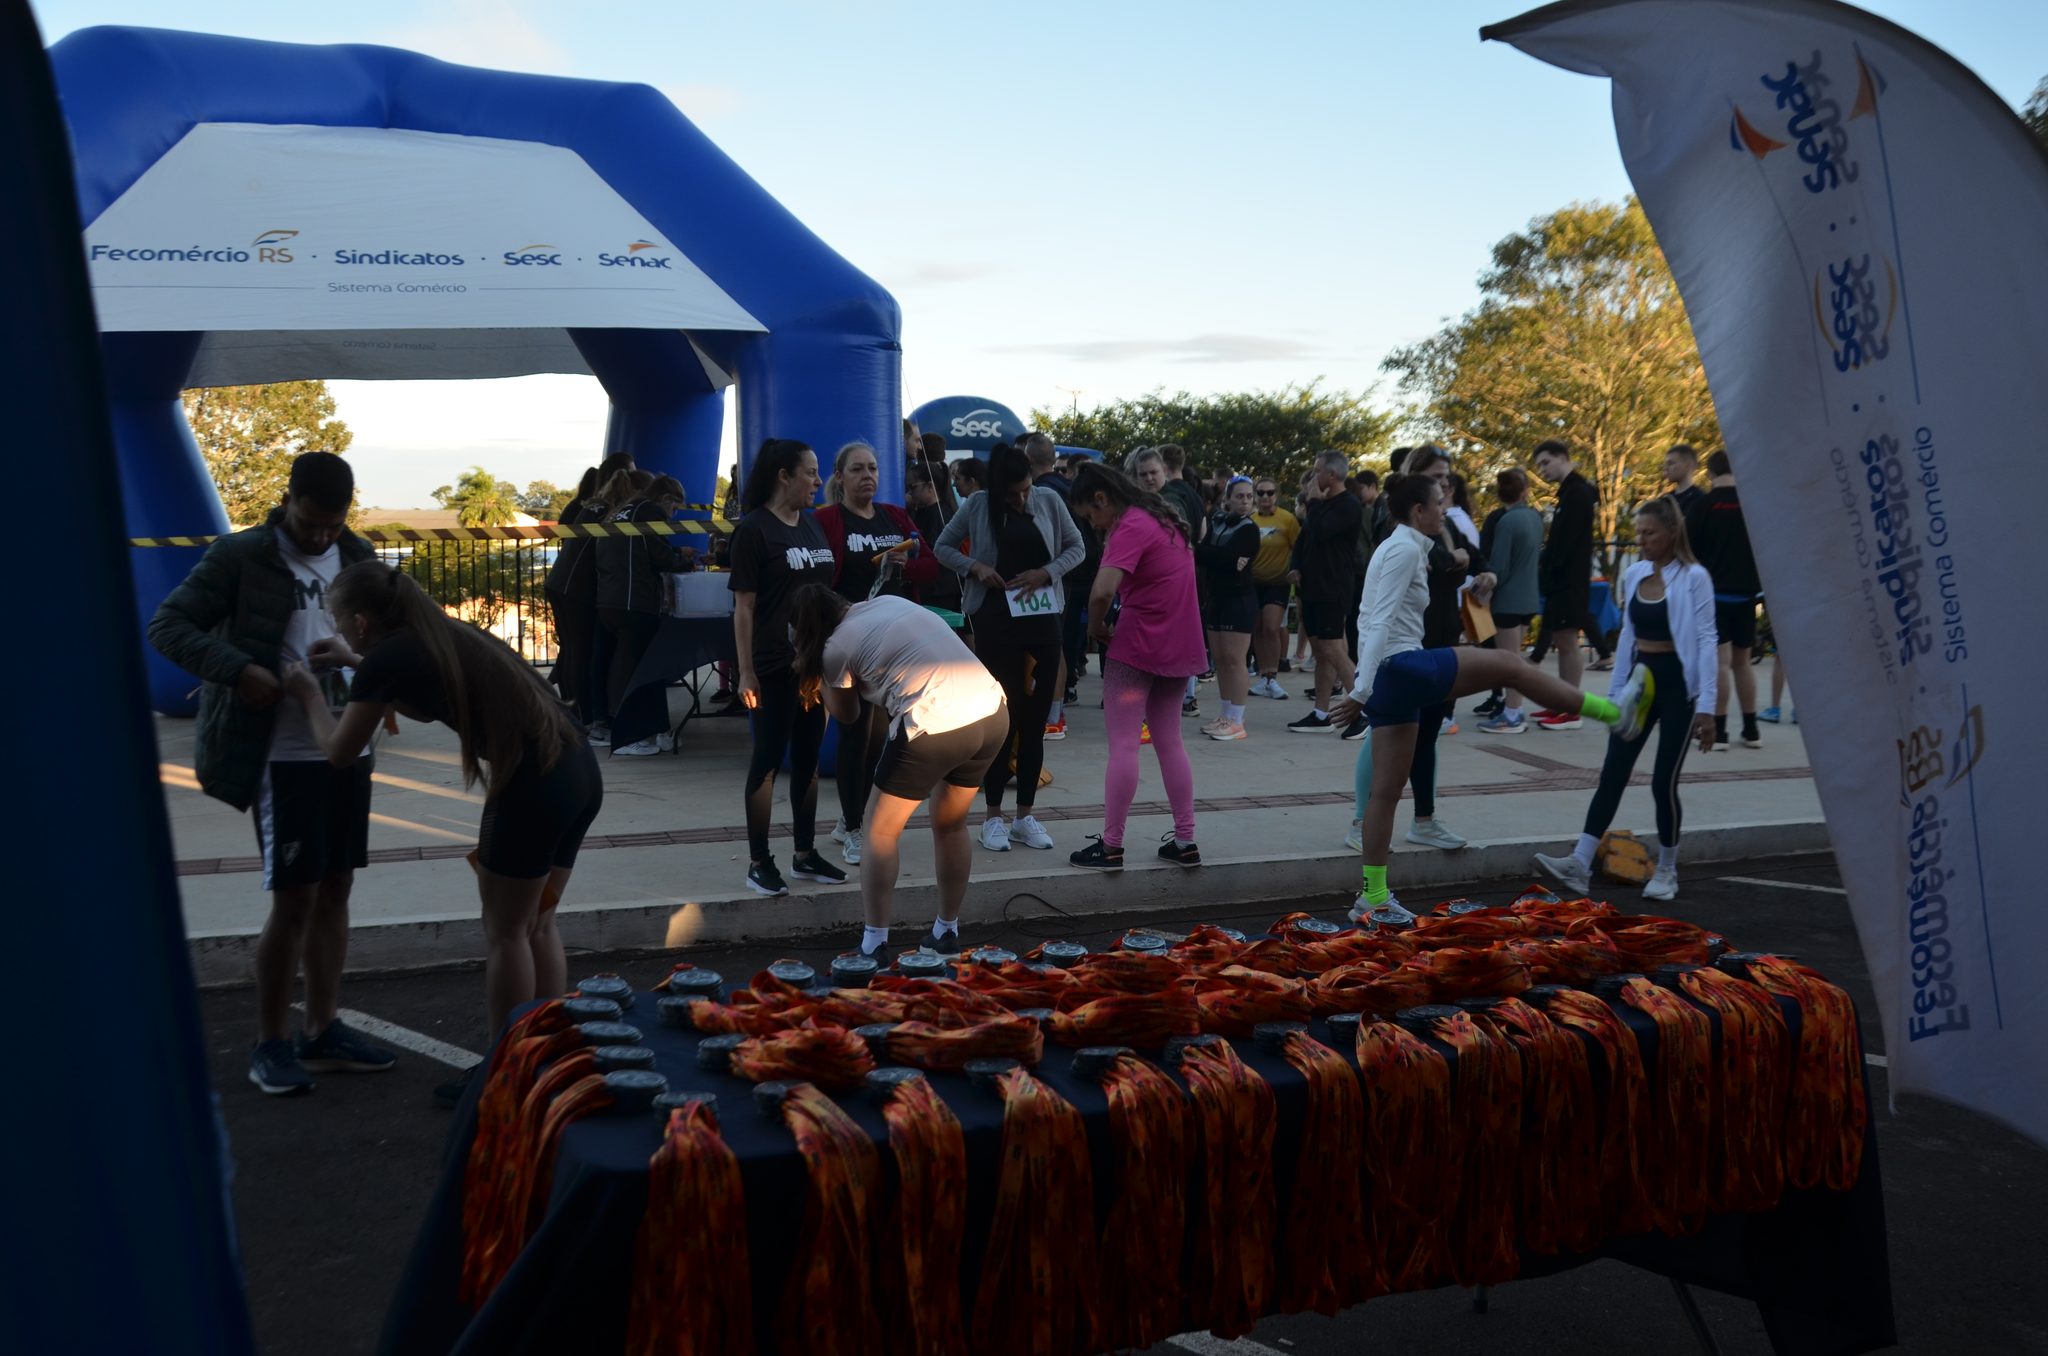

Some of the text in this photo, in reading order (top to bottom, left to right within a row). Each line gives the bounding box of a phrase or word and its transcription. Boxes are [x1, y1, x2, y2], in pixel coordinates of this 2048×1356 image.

[1760, 61, 1837, 193] Senac
[91, 244, 672, 270] Fecomércio RS Sindicatos Sesc Senac
[328, 281, 467, 293] Sistema Comércio
[1829, 258, 1861, 373] Sesc
[950, 417, 1002, 438] Sesc
[1016, 592, 1052, 612] 104
[1860, 439, 1914, 667] Sindicatos
[1912, 426, 1967, 663] Sistema Comércio
[1907, 730, 1939, 1042] Fecomércio RS
